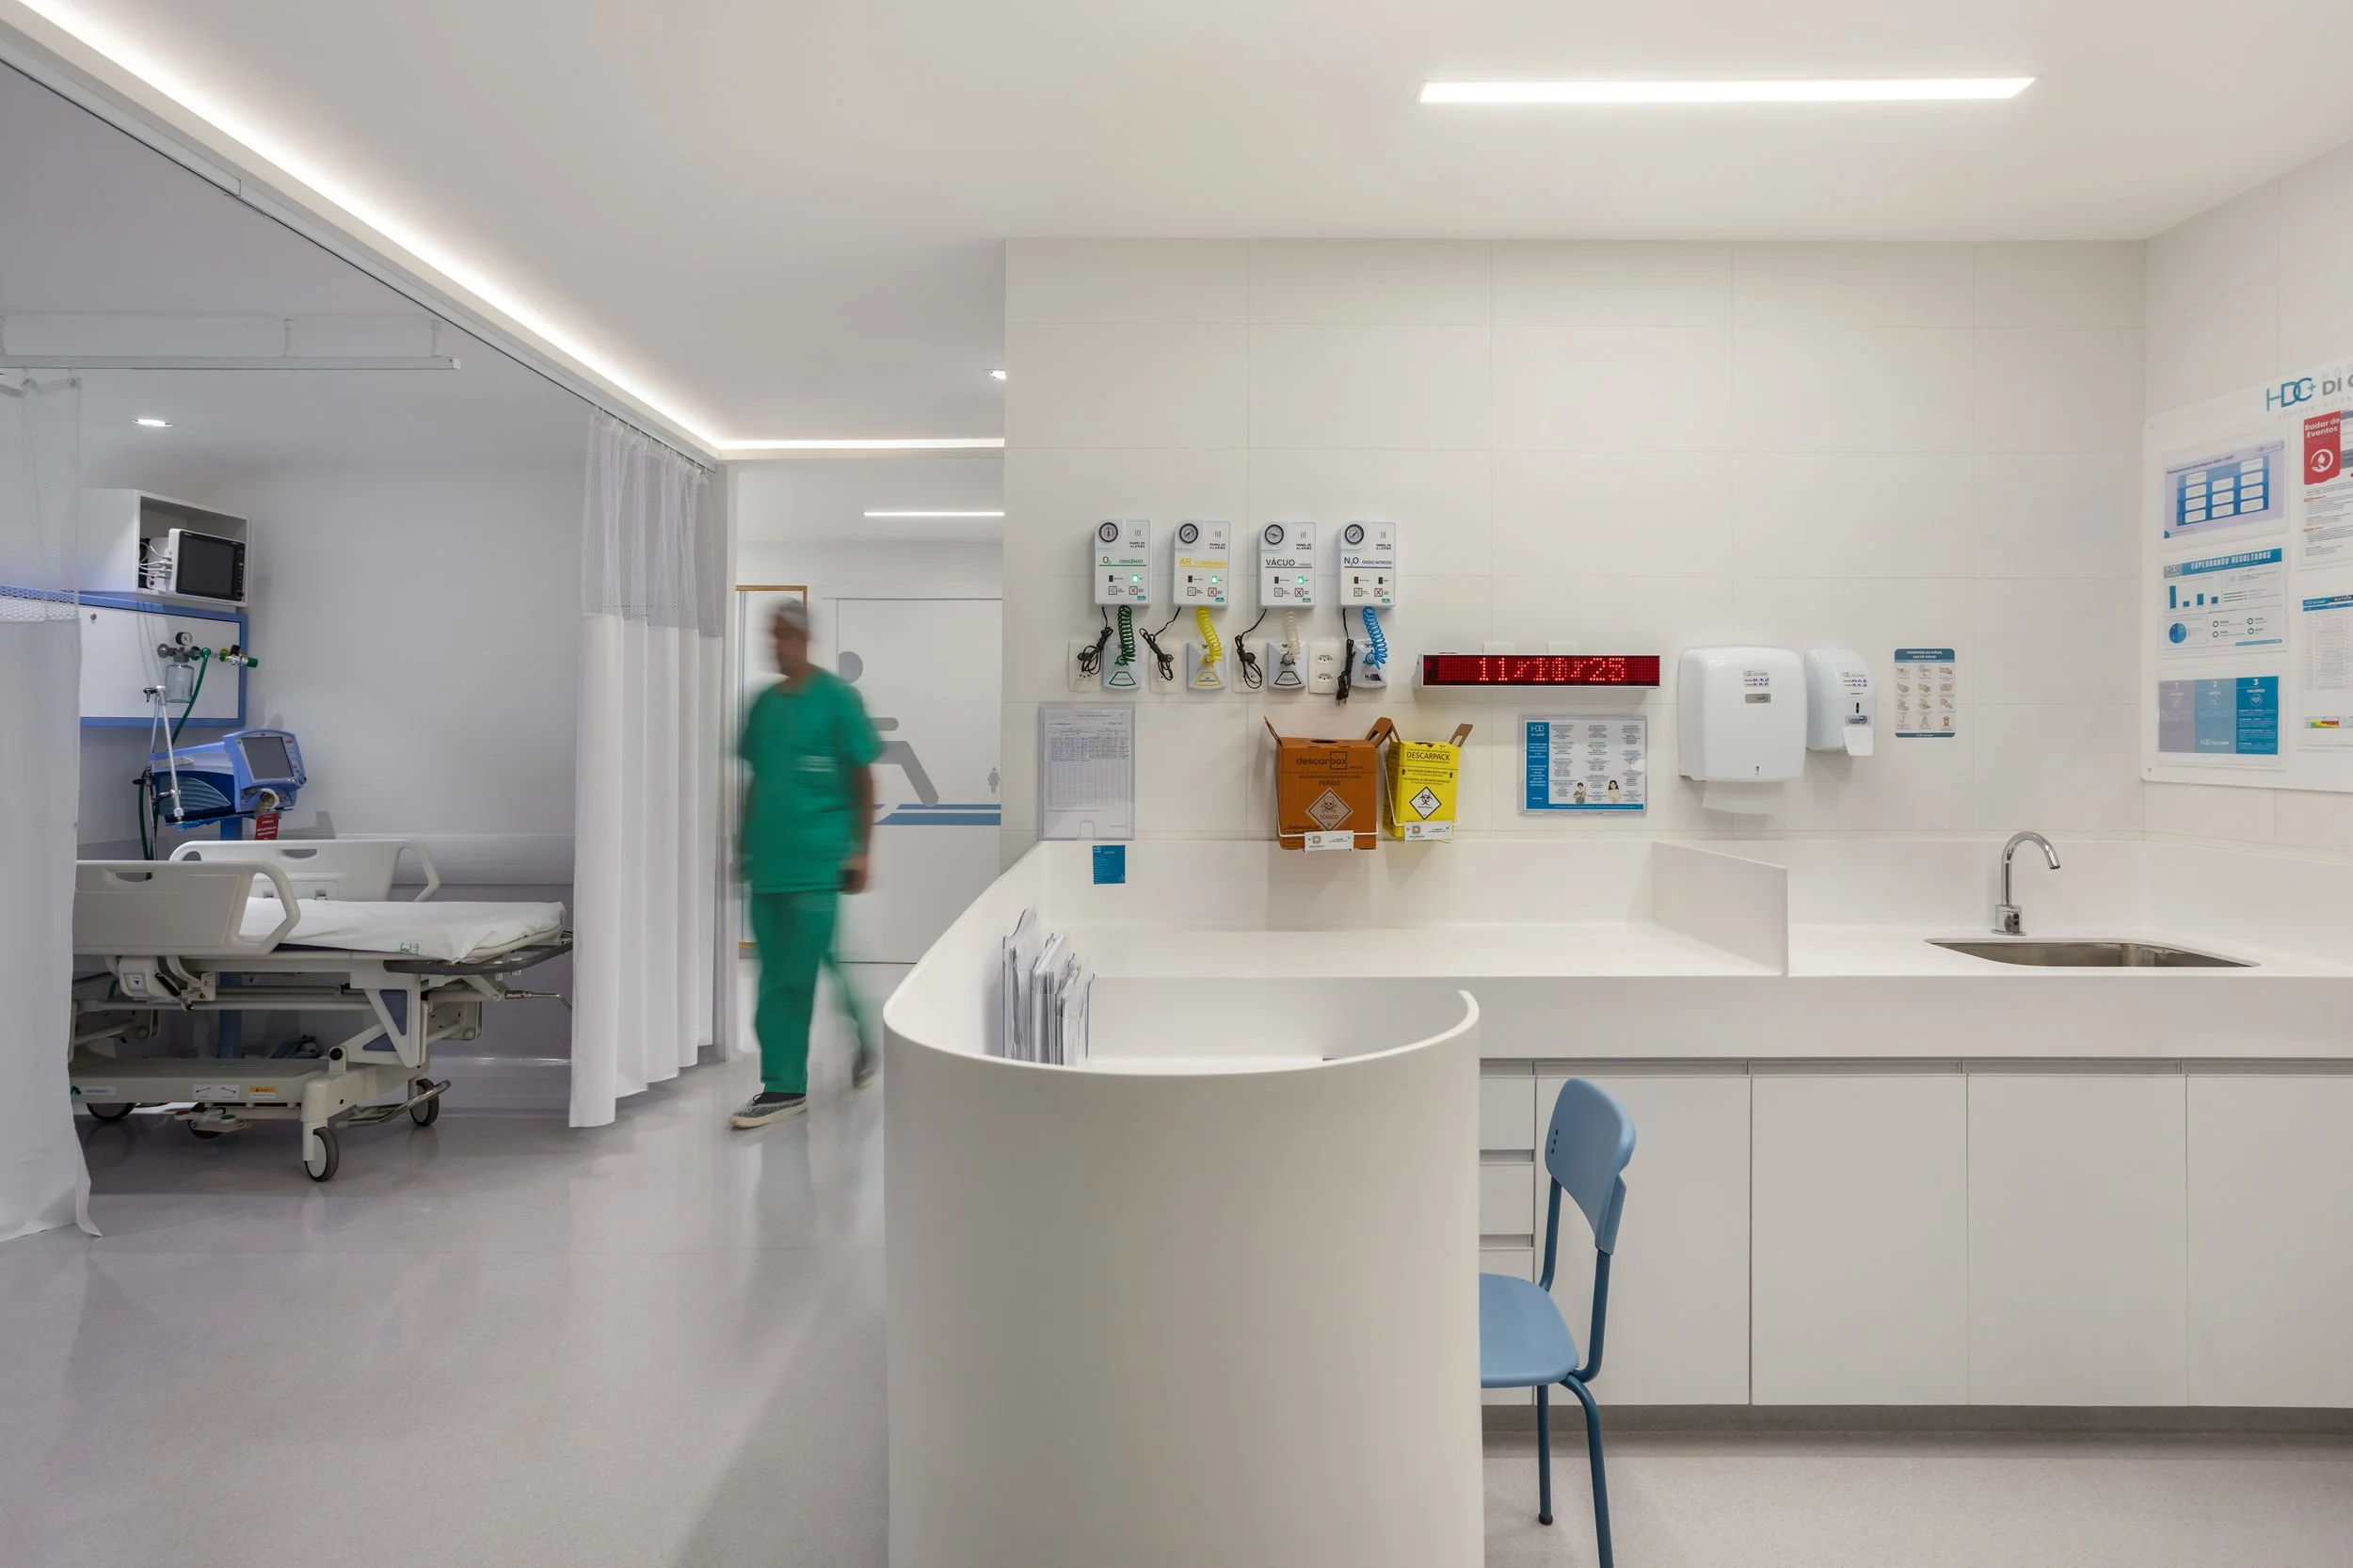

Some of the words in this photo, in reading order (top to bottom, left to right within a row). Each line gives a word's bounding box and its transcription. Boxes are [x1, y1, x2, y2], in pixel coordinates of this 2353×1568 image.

[2322, 376, 2342, 395] DI
[2304, 421, 2329, 431] Radar
[2306, 425, 2338, 438] Eventos
[1179, 557, 1192, 566] AR
[1265, 557, 1296, 567] VÁCUO
[2190, 557, 2230, 570] EXPLORANDO
[2231, 551, 2271, 564] RESULTADOS
[1296, 756, 1348, 765] descarbox
[1406, 751, 1450, 761] DESCARPACK
